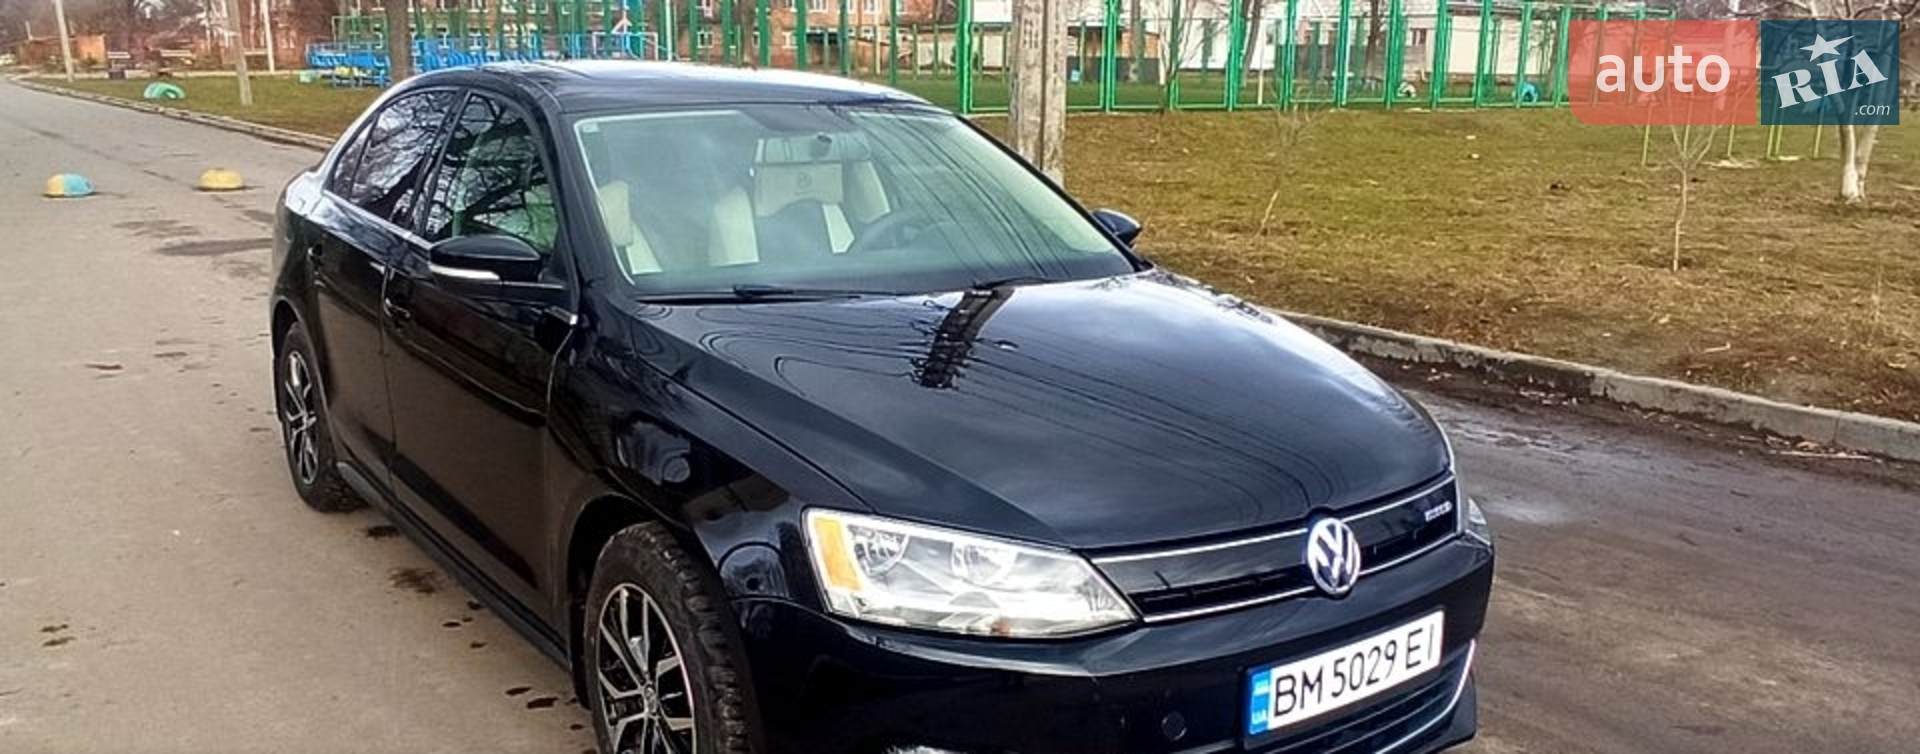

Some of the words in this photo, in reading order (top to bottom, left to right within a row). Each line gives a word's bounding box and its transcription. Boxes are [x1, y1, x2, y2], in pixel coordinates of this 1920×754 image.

[1273, 664, 1324, 717] BM
[1331, 639, 1398, 698] 5029
[1405, 623, 1435, 670] EI
